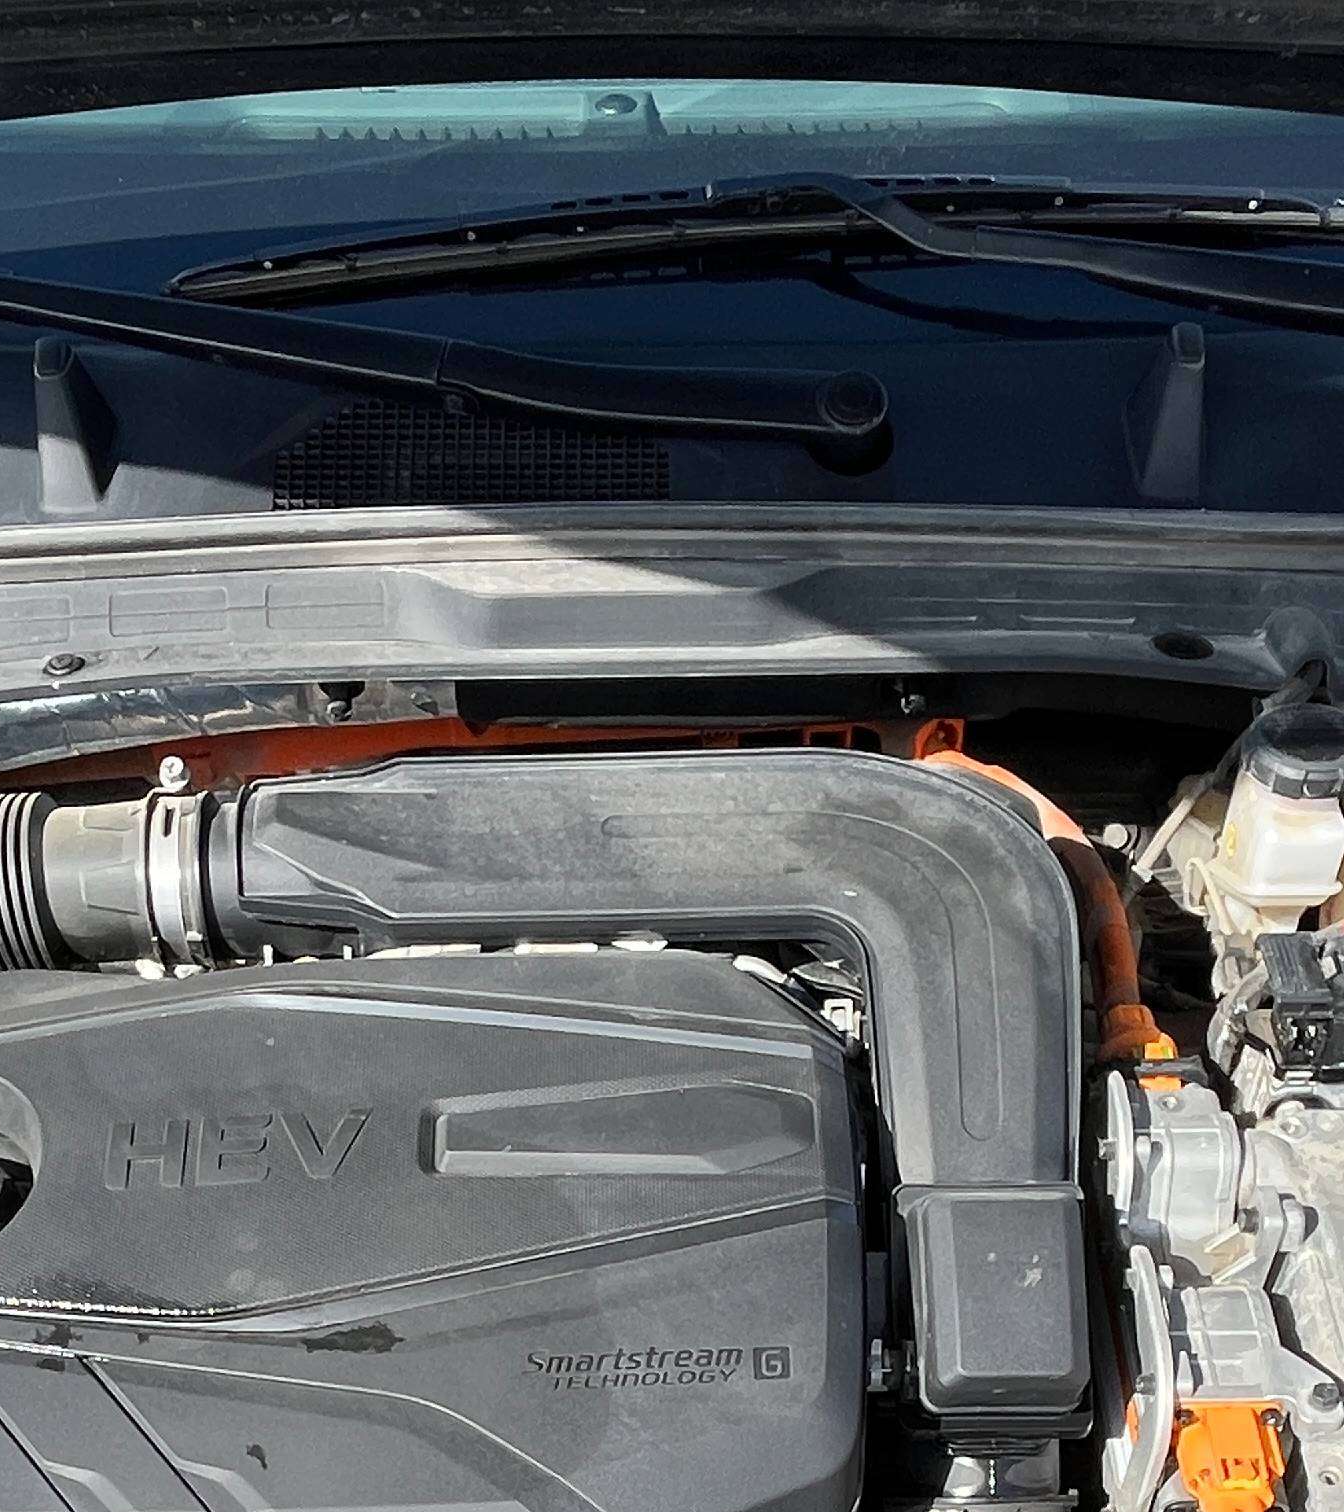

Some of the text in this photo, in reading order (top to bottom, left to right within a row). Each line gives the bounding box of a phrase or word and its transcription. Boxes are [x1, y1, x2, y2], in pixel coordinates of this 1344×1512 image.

[104, 1107, 374, 1191] HEV
[524, 1345, 785, 1377] Smartstream G
[552, 1368, 738, 1391] TECHNOLOGY
